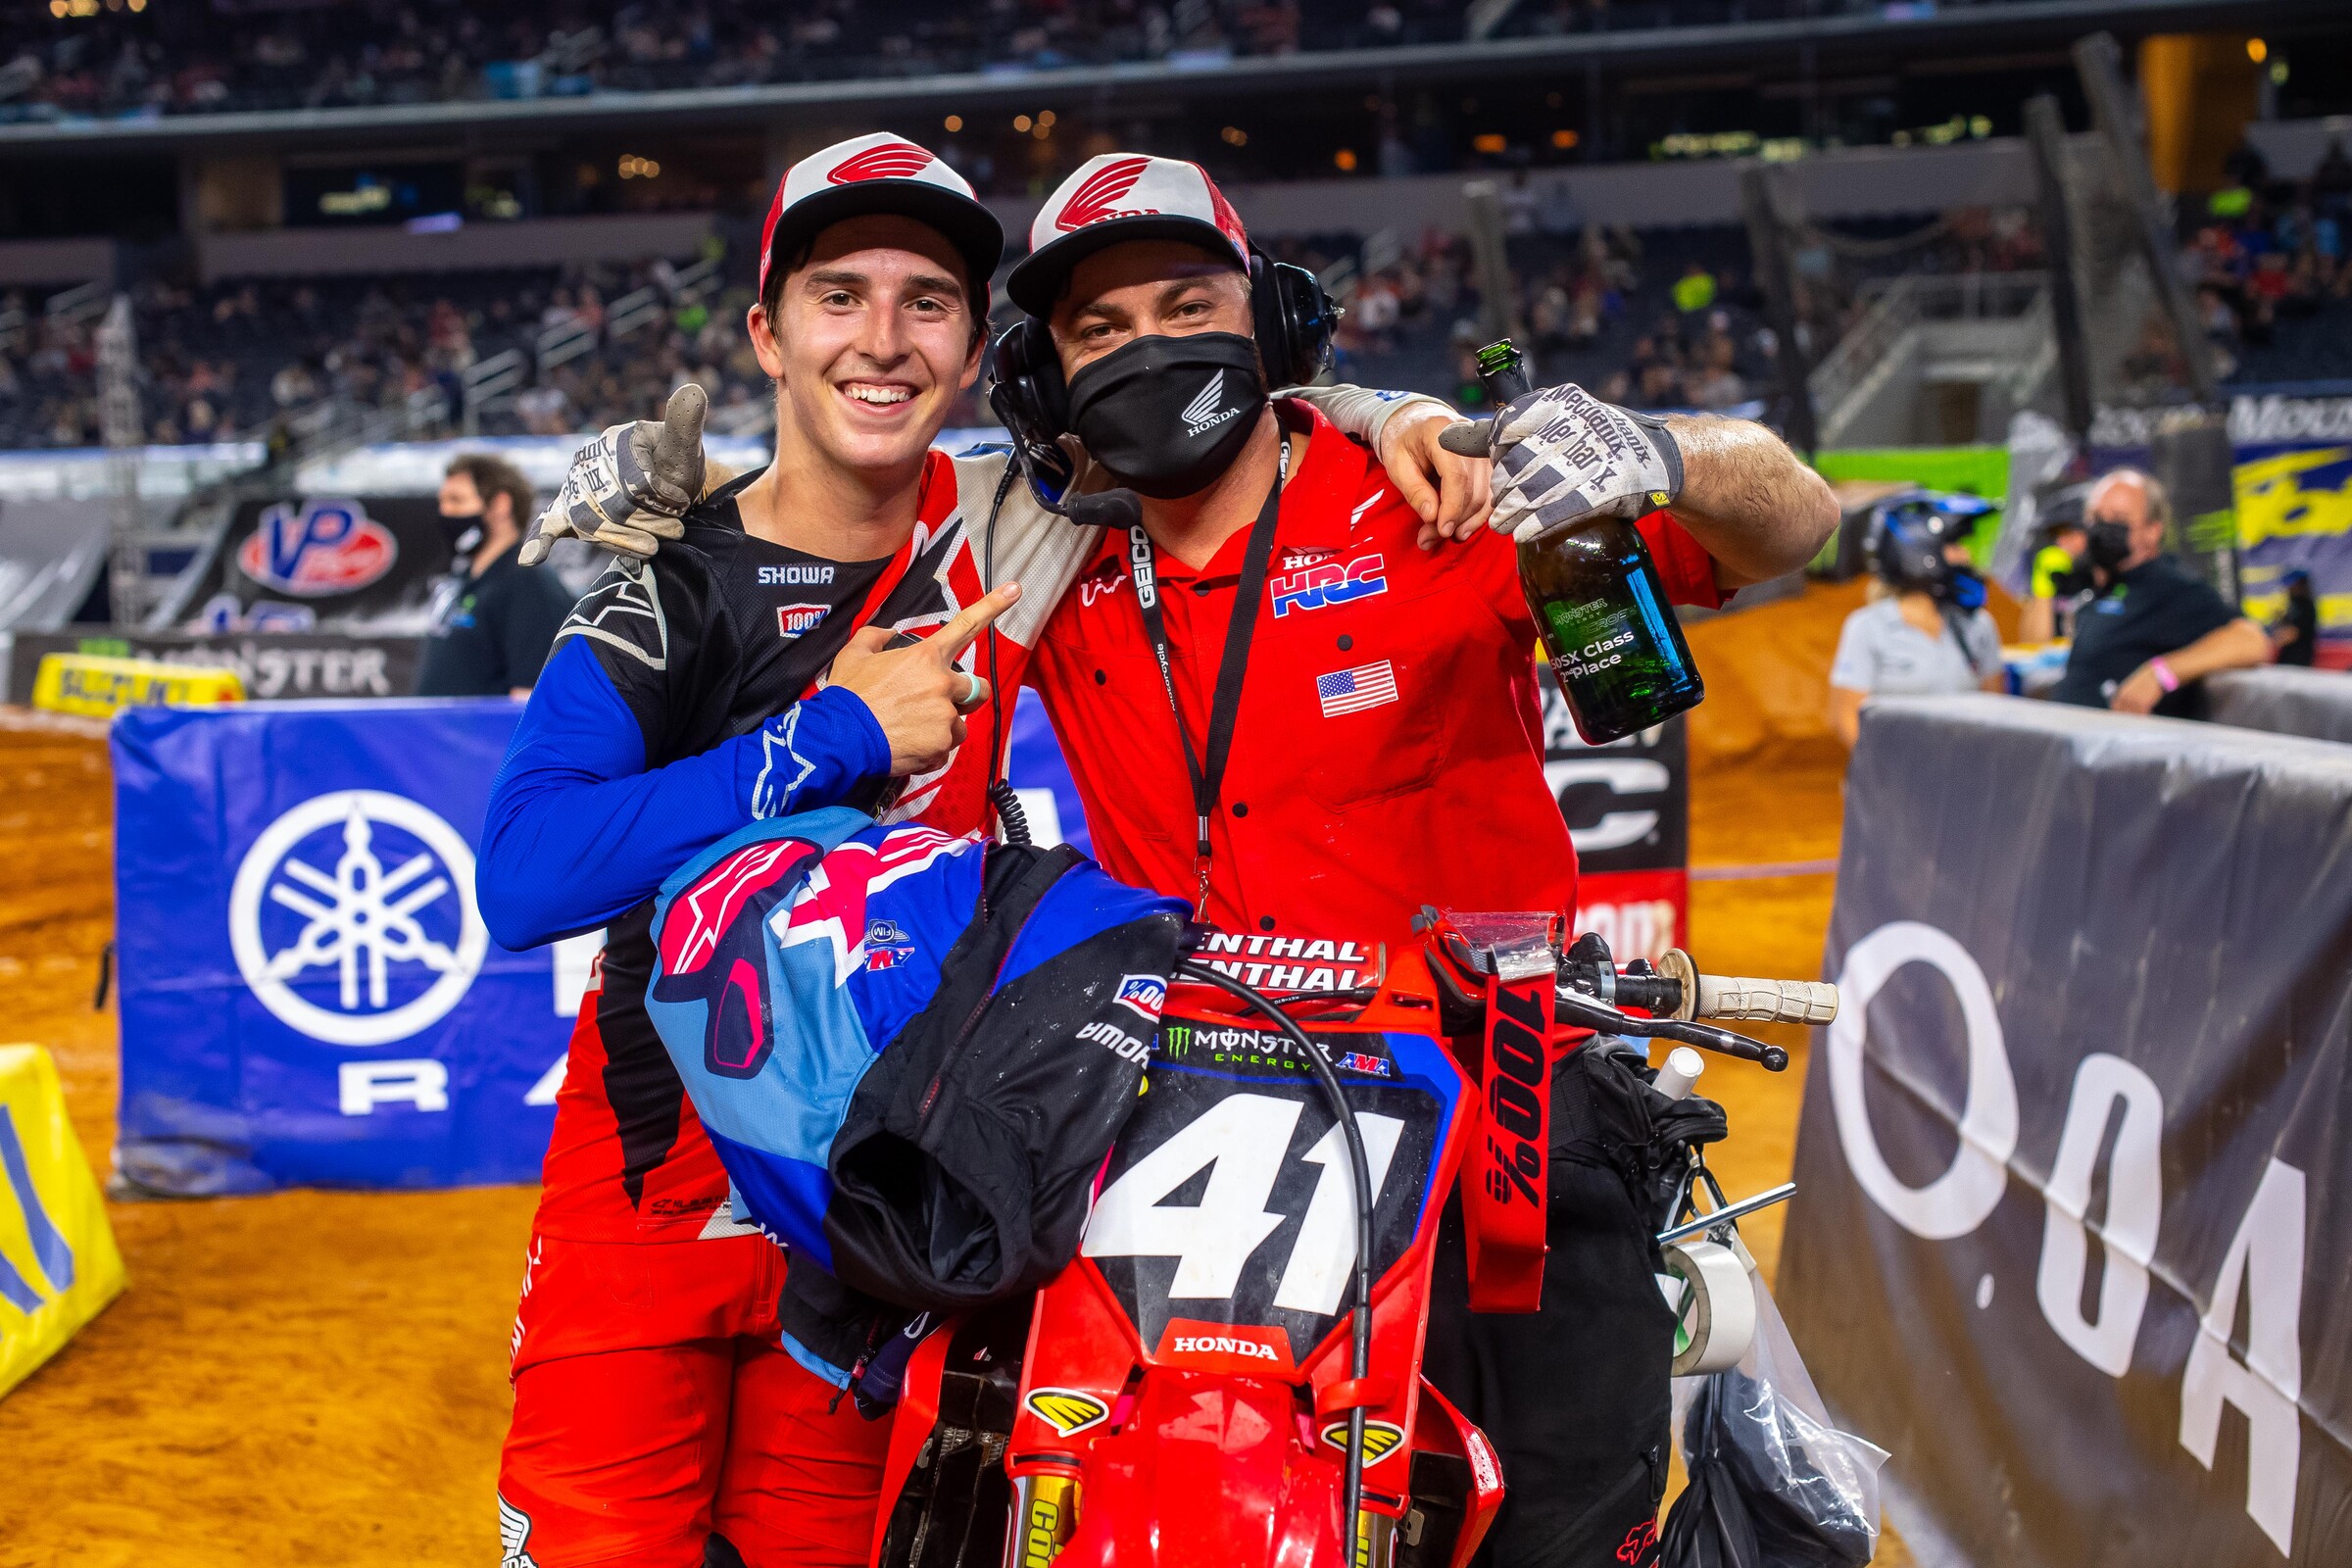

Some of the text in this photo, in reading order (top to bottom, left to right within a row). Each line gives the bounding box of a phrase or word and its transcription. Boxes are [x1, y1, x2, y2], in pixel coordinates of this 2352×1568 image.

[1187, 407, 1241, 437] HONDA
[267, 505, 359, 582] VP
[758, 566, 835, 584] SHOWA
[1130, 524, 1156, 610] GEICO
[1270, 553, 1388, 618] HRC
[785, 610, 826, 630] 100%
[1553, 598, 1607, 625] MONSTER
[1584, 631, 1635, 658] Class
[1572, 654, 1622, 679] Place
[874, 926, 891, 936] FIM
[1076, 1022, 1151, 1070] HOWA
[1214, 1054, 1311, 1071] ENERGY
[1335, 1052, 1392, 1078] AMA
[1486, 986, 1545, 1209] 100%
[1082, 1093, 1405, 1316] 41
[1174, 1337, 1278, 1361] HONDA
